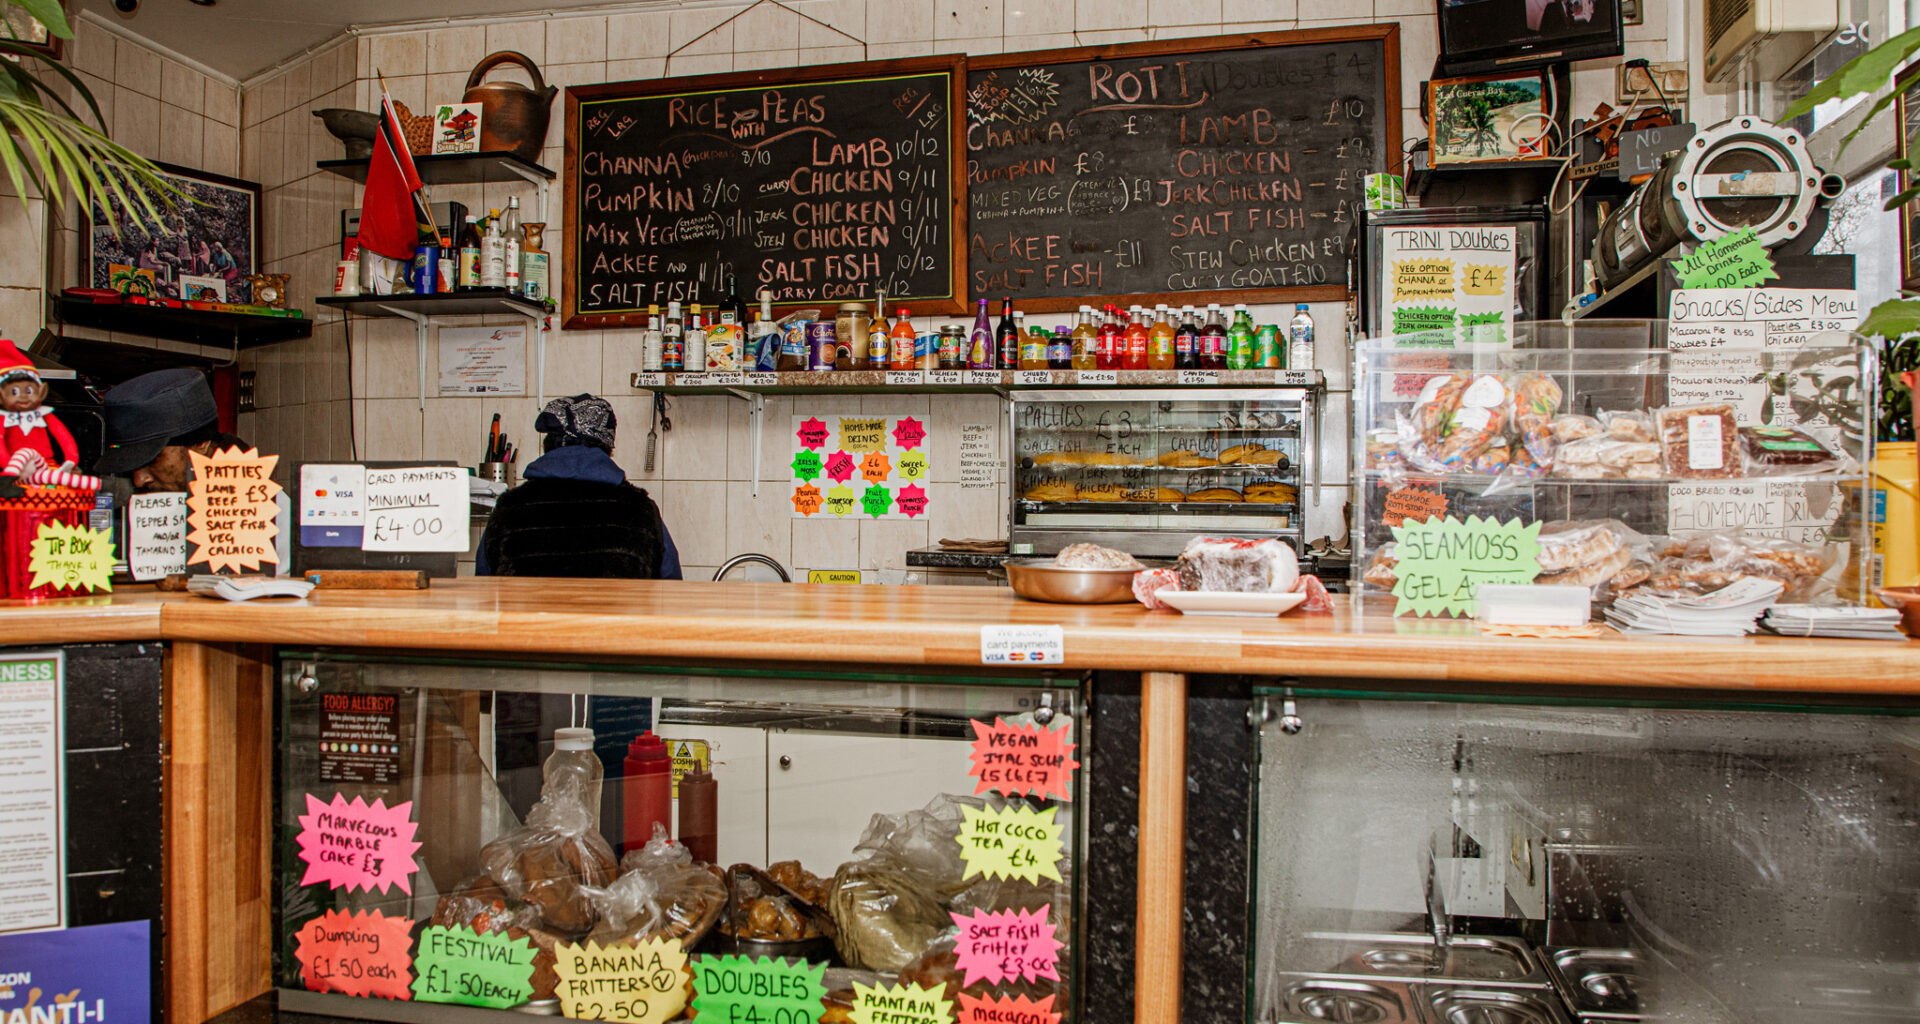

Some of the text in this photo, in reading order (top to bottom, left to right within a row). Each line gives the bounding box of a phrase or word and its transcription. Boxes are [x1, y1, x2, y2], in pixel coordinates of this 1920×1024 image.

[1089, 61, 1191, 103] ROTI
[1488, 86, 1504, 96] Bay
[669, 90, 826, 129] RICE PEAS
[892, 88, 919, 113] REG
[587, 109, 608, 131] REG
[1180, 99, 1364, 145] LAMB £10
[731, 121, 766, 140] WITH
[812, 129, 939, 169] LAMB 10/12
[1635, 130, 1661, 151] NO
[742, 149, 771, 168] 8/10
[1177, 149, 1290, 178] CHICKEN
[759, 164, 936, 195] CURRY CHICKEN 9/11
[1574, 166, 1593, 176] I'M A
[972, 185, 1062, 208] MIXED VEG
[1156, 177, 1301, 206] JERK CHICKEN
[754, 190, 938, 226] JERK CHICKEN 9/11
[636, 213, 675, 246] VEG
[1170, 208, 1305, 238] SALT FISH
[754, 216, 938, 250] STEW CHICKEN 9/11
[1391, 230, 1442, 249] TRINI
[970, 232, 1061, 263] ACKEE
[1170, 235, 1344, 272] STEW CHICKEN £9
[1684, 232, 1758, 276] All Homemade
[592, 251, 687, 274] ACKEE AND
[758, 246, 936, 283] SALT FISH 10/12
[1400, 264, 1449, 273] VEG OPTION
[1740, 261, 1763, 280] Each
[975, 261, 1102, 293] SALT FISH
[1231, 263, 1327, 288] GOAT £10
[1398, 275, 1436, 285] CHANNA
[1470, 268, 1497, 288] £4
[587, 281, 700, 307] SALT FISH
[755, 282, 869, 301] CURRY GOAT
[1811, 294, 1857, 315] Menu
[1398, 312, 1430, 321] CHICKEN
[1398, 322, 1416, 330] JERK
[1811, 320, 1841, 330] £3.00
[1669, 326, 1712, 336] Macaroni
[1713, 326, 1726, 335] Pie
[1768, 335, 1807, 346] Chicken
[1710, 338, 1726, 348] £4
[847, 433, 880, 444] DRINKS
[1106, 443, 1141, 456] EACH
[204, 465, 263, 480] PATTIES
[829, 457, 851, 478] FRESH
[868, 458, 880, 468] £6
[367, 471, 457, 485] CARD PAYMENTS
[1022, 466, 1108, 487] CHICKEN JERK
[205, 484, 268, 503] LAMB £3
[335, 490, 354, 498] VISA
[368, 493, 431, 507] MINIMUM
[864, 496, 885, 505] Punch
[865, 488, 883, 496] Fruit
[1074, 482, 1156, 500] CHICKEN CHEESE
[1670, 487, 1691, 496] COCO
[134, 497, 172, 509] PLEASE
[206, 497, 238, 506] BEEF
[796, 497, 817, 507] Punch
[1405, 503, 1424, 512] STOP
[136, 515, 168, 528] PEPPER
[205, 507, 257, 518] CHICKEN
[1670, 501, 1776, 529] HOMEMADE
[206, 518, 267, 531] SALT FISH
[374, 515, 443, 542] £4.00
[44, 536, 93, 555] TIP BOX
[208, 533, 235, 545] VEG
[1405, 531, 1519, 561] SEAMOSS
[47, 560, 81, 570] THANK
[135, 565, 157, 574] WITH
[1403, 573, 1449, 600] GEL
[987, 639, 1059, 652] card payments
[985, 653, 1005, 661] VISA
[324, 694, 395, 712] FOOD ALLERGY?
[988, 733, 1038, 748] VEGAN
[984, 753, 1064, 768] ITAL SOUP
[317, 812, 398, 838] MARVELOUS
[975, 819, 1047, 840] HOT COCO
[320, 832, 381, 851] MARBLE
[319, 849, 355, 866] CAKE
[971, 836, 1038, 867] TEA £4
[314, 925, 380, 954] Dumpling
[969, 925, 1002, 940] SALT
[431, 933, 523, 966] FESTIVAL
[313, 955, 397, 980] £1.50 each
[574, 951, 663, 975] BANANA
[999, 958, 1052, 975] £3.00
[426, 964, 521, 1002] £1.50 EACH
[568, 976, 650, 998] FRITTERS
[704, 967, 809, 1000] DOUBLES
[574, 998, 649, 1020] £2.50
[864, 993, 936, 1015] PLANTAIN
